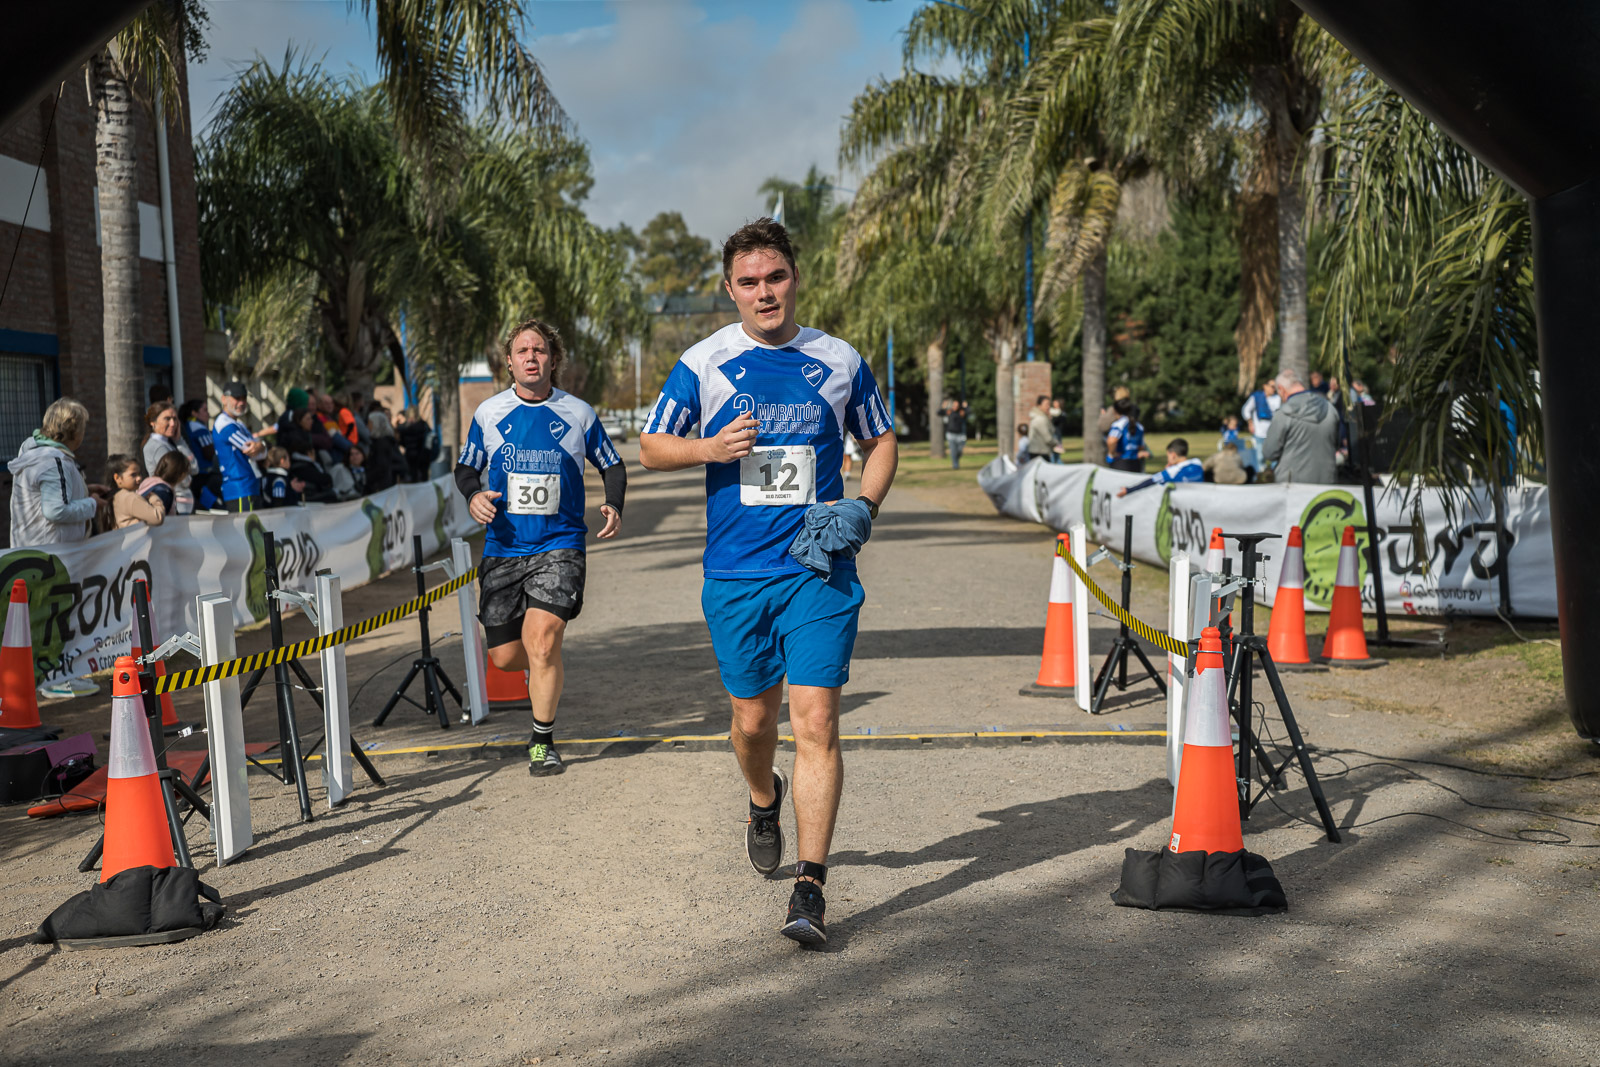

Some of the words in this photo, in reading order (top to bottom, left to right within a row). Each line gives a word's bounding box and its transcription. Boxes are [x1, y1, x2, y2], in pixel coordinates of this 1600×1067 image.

[758, 401, 821, 422] MARATÓN
[502, 443, 516, 473] 3
[517, 449, 561, 464] MARATÓN
[760, 463, 799, 491] 12
[518, 486, 548, 505] 30
